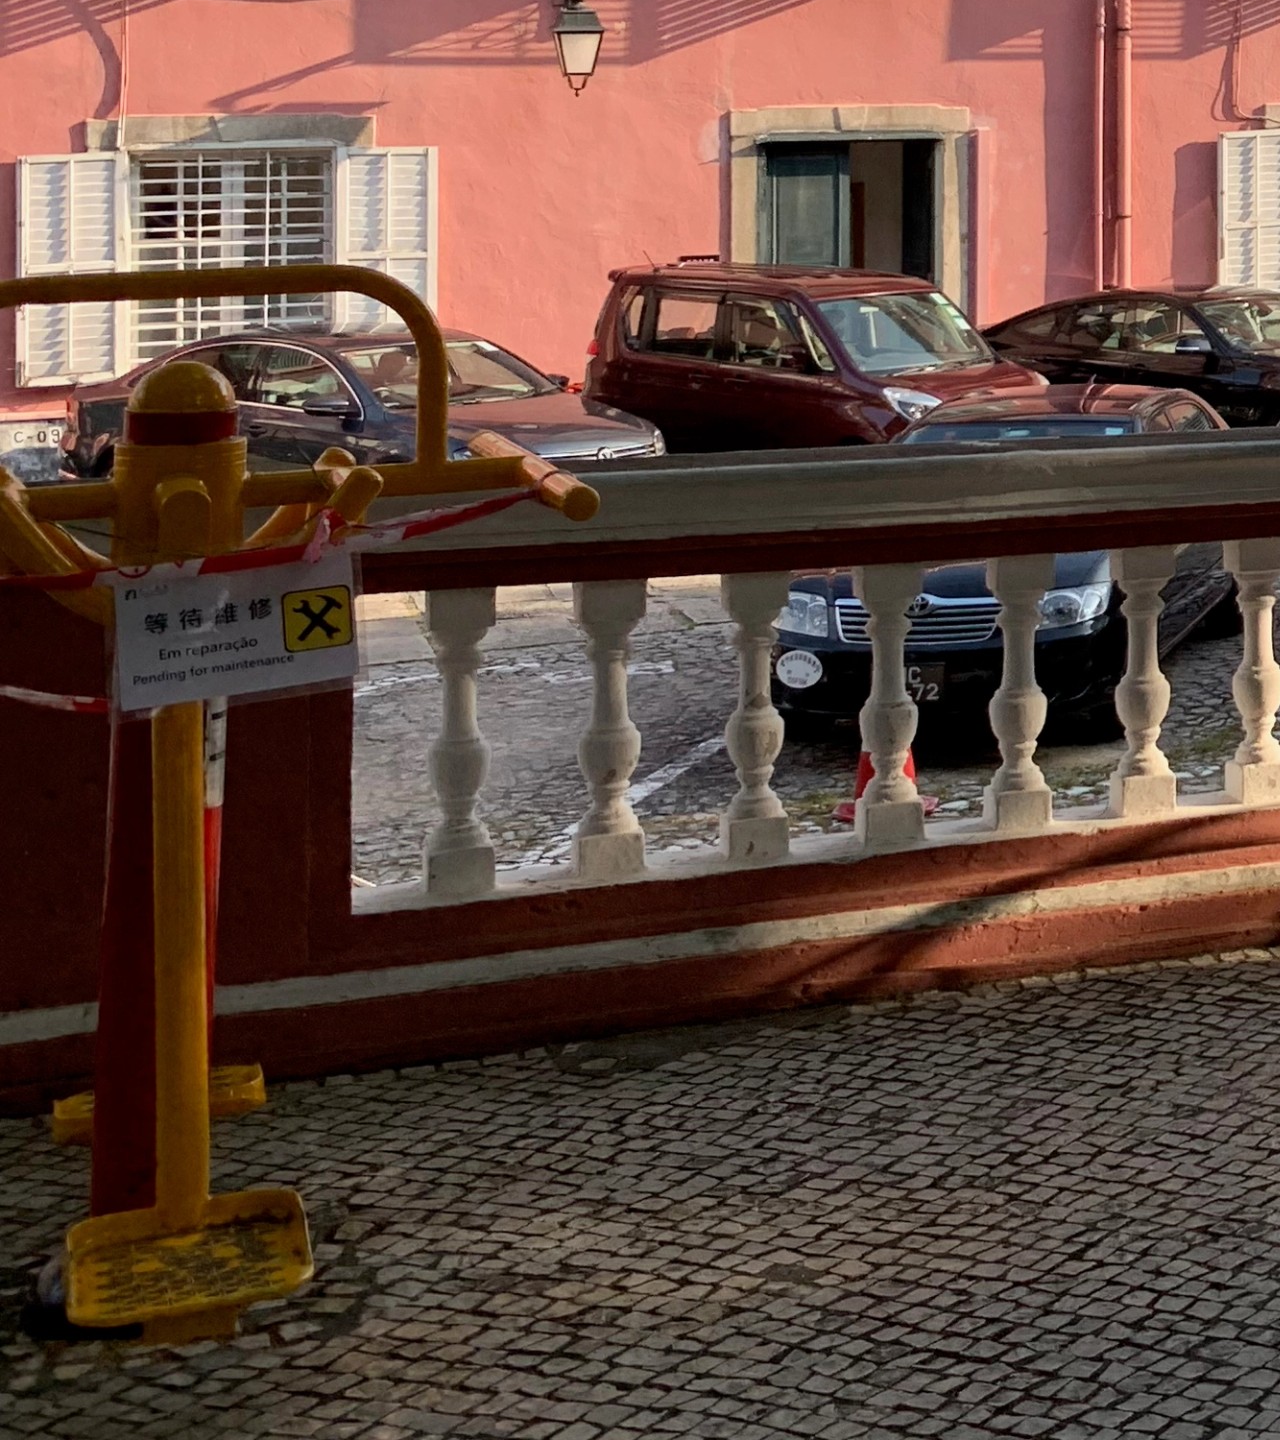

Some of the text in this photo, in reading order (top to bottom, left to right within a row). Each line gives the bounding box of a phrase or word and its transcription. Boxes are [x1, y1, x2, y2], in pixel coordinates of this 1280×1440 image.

[13, 428, 60, 444] C-09
[143, 598, 272, 635] 等待維修
[158, 637, 259, 661] Em reparação
[132, 653, 295, 686] Pending for maintenance
[906, 666, 922, 683] C
